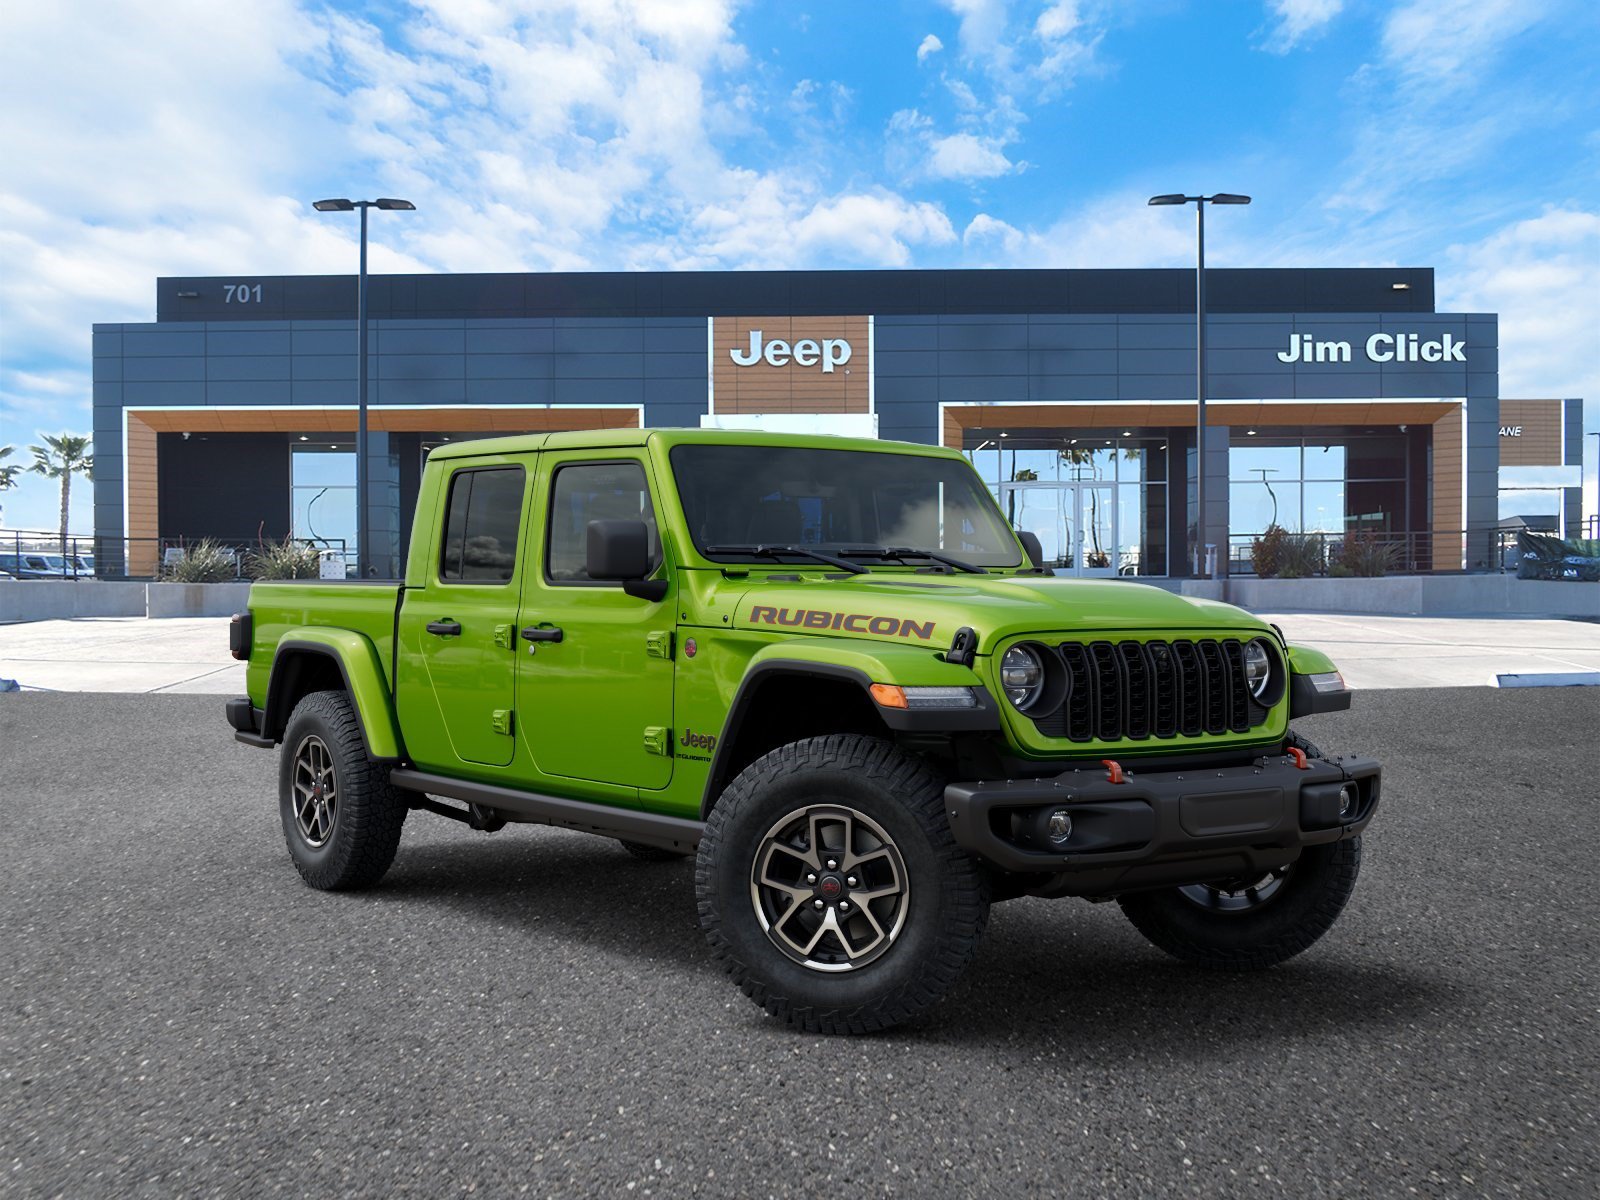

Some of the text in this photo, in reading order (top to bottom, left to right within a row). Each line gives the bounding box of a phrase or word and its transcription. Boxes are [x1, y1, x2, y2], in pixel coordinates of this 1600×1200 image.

[223, 284, 262, 303] 701
[729, 330, 852, 373] Jeep
[1277, 333, 1467, 362] Jim Click
[1498, 426, 1522, 437] ANE
[749, 605, 936, 640] RUBICON
[680, 727, 717, 753] Jeep
